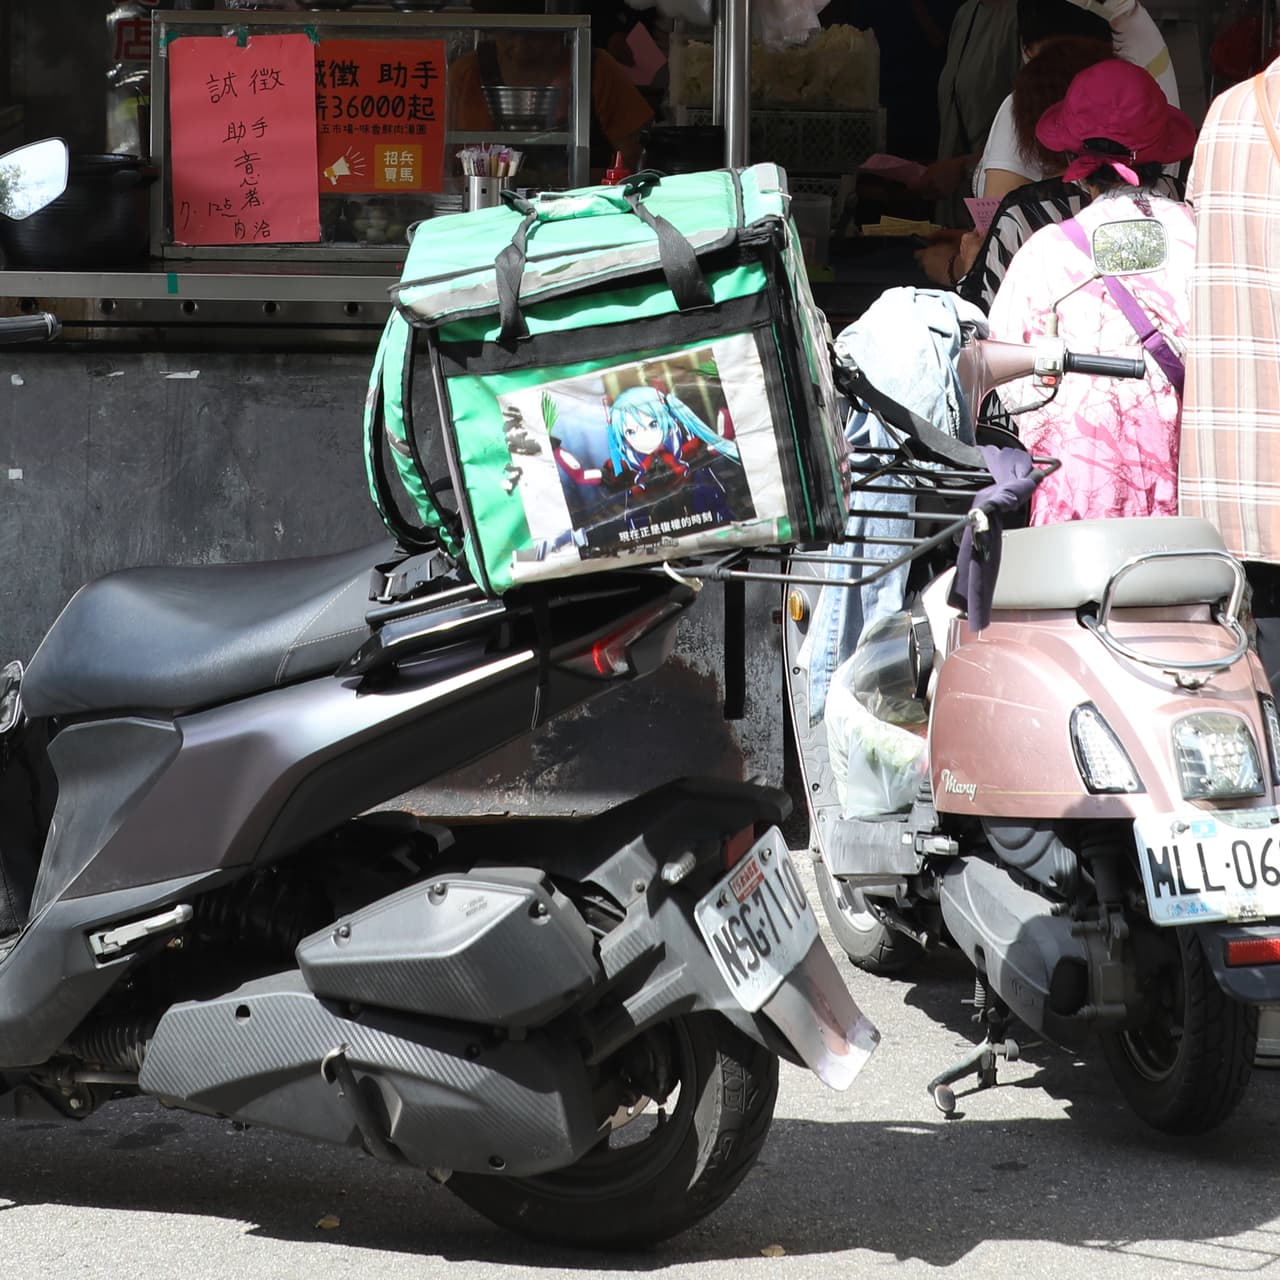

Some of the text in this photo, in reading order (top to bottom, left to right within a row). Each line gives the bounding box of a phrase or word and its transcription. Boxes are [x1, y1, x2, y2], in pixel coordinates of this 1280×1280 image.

[205, 68, 285, 104] 誠徵
[378, 61, 438, 88] 助手
[223, 116, 268, 144] 助手
[384, 150, 414, 166] 招兵
[384, 168, 414, 183] 買馬
